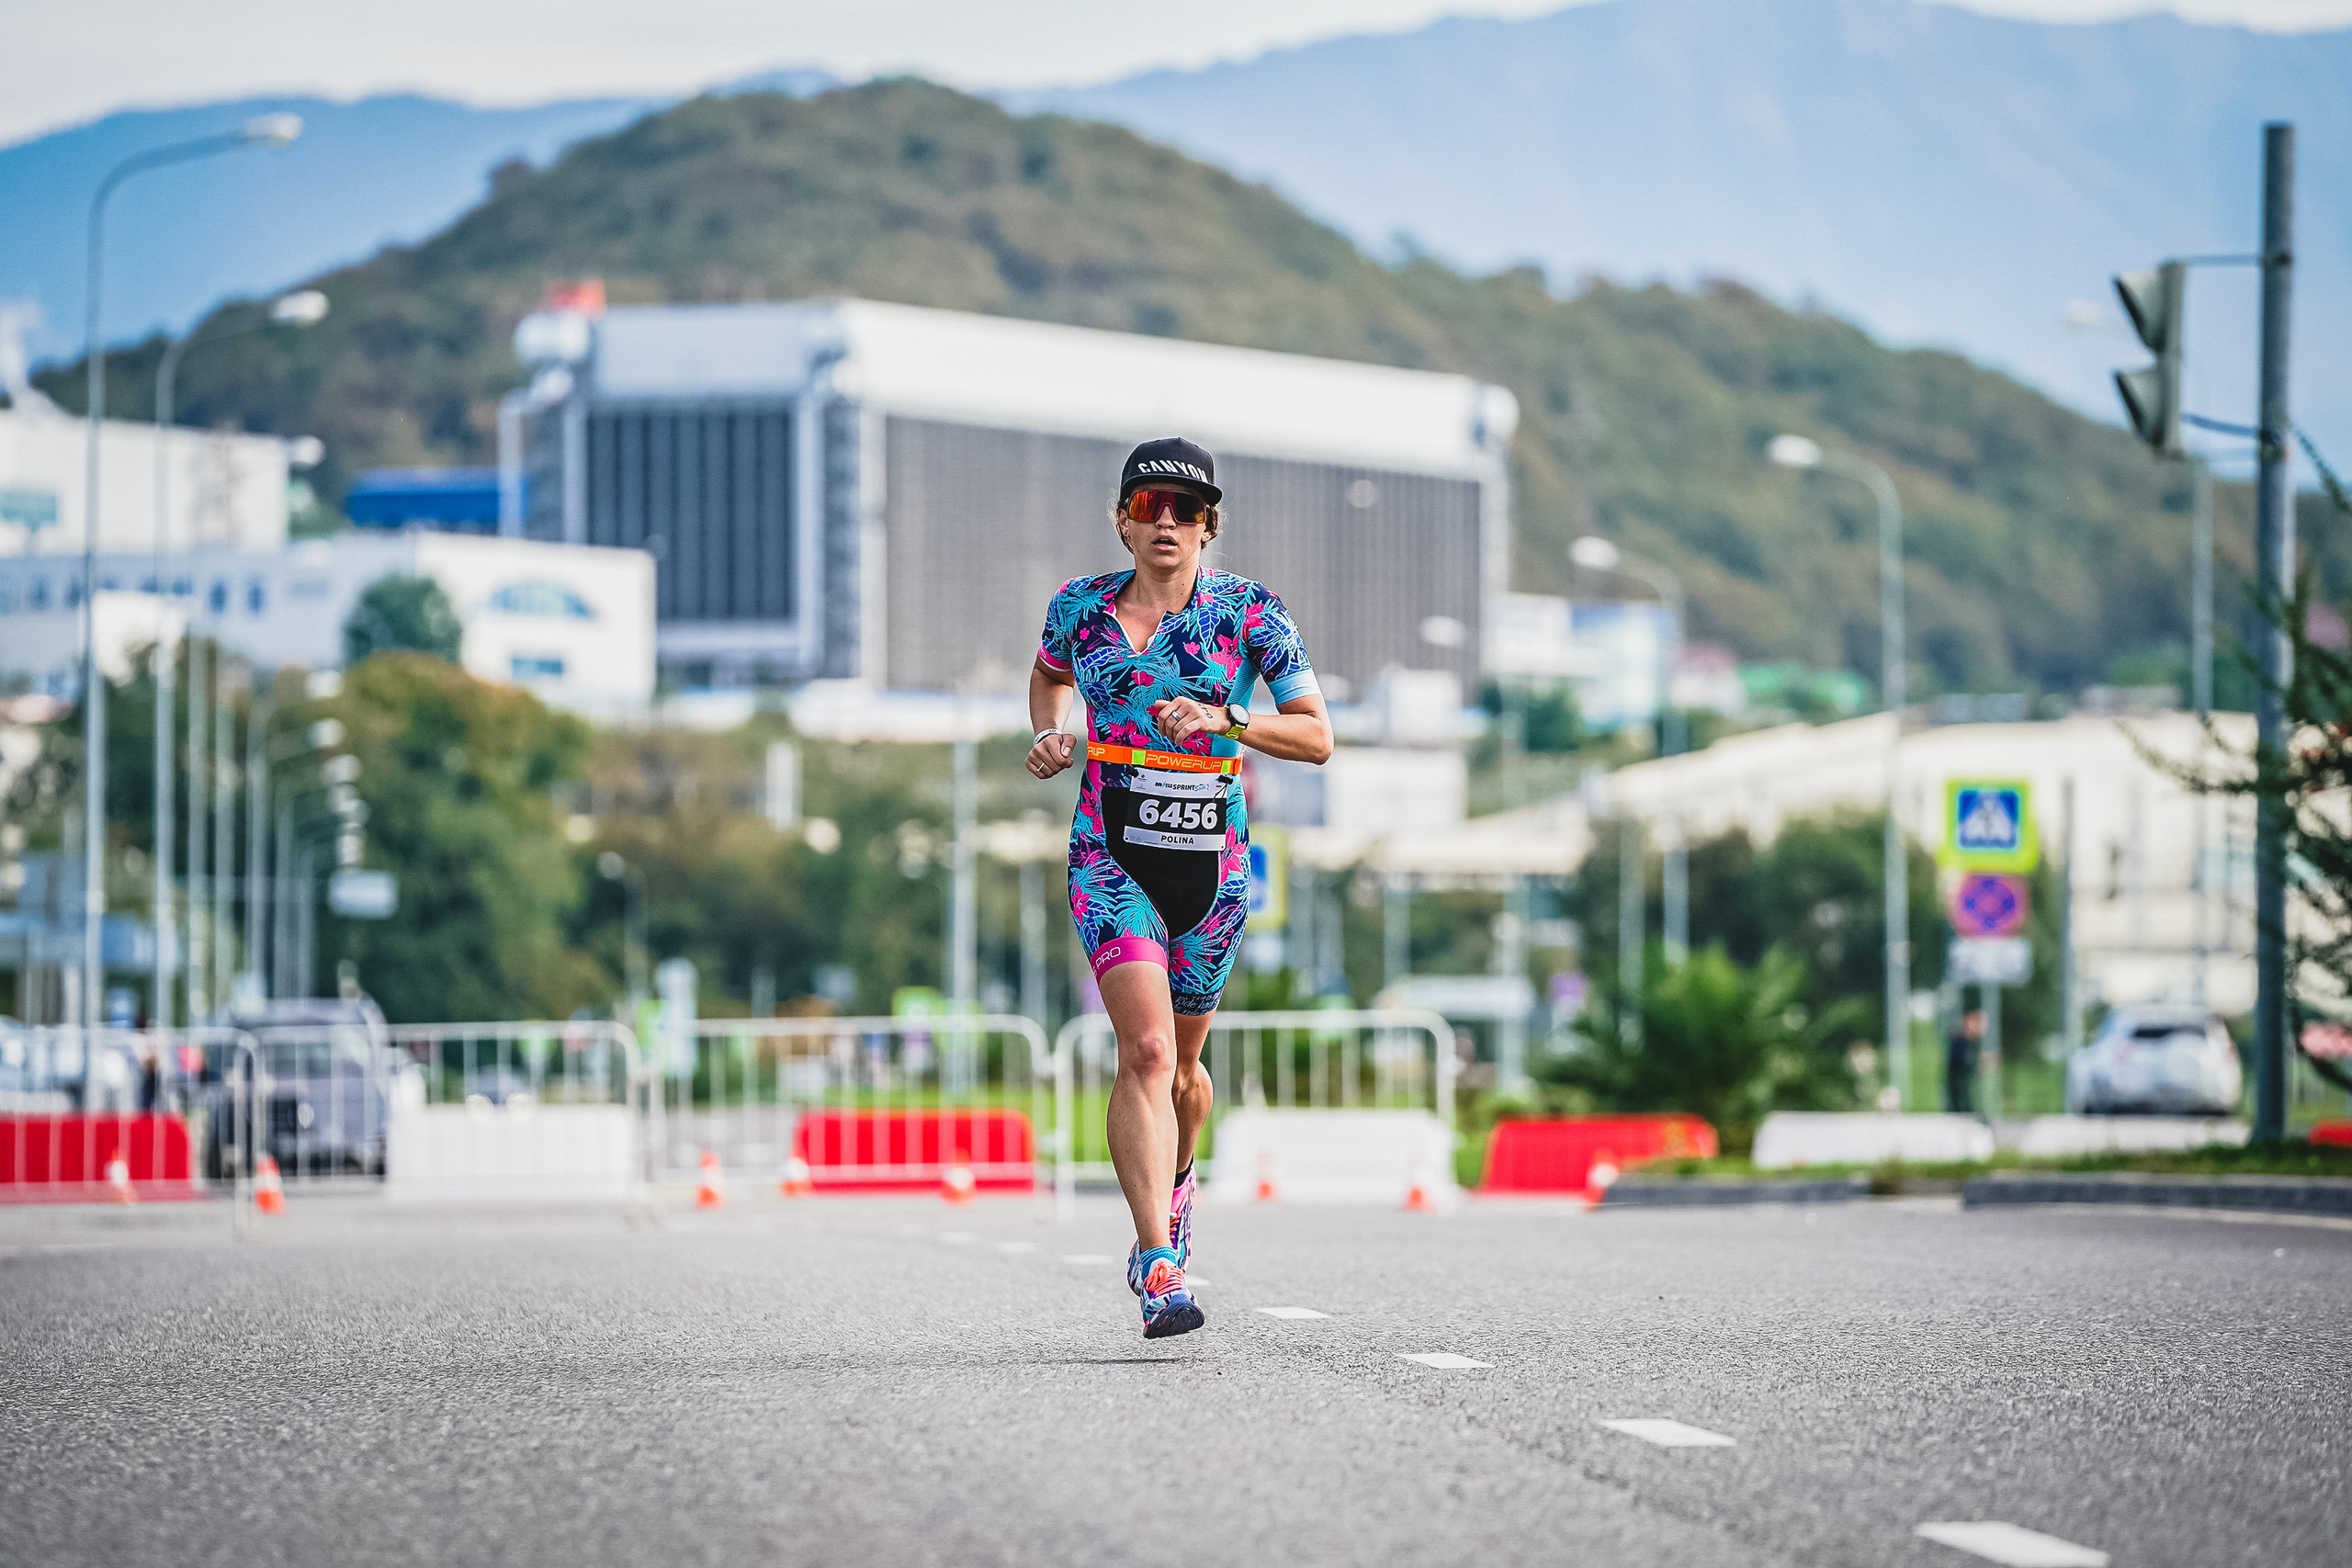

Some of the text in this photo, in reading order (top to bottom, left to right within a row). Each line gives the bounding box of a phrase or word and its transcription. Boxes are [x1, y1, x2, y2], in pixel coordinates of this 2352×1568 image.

[1138, 460, 1208, 483] CANYON
[1146, 754, 1221, 769] POWERUP
[1139, 799, 1217, 829] 6456
[1160, 835, 1194, 844] POLINA
[1095, 946, 1121, 969] PRO
